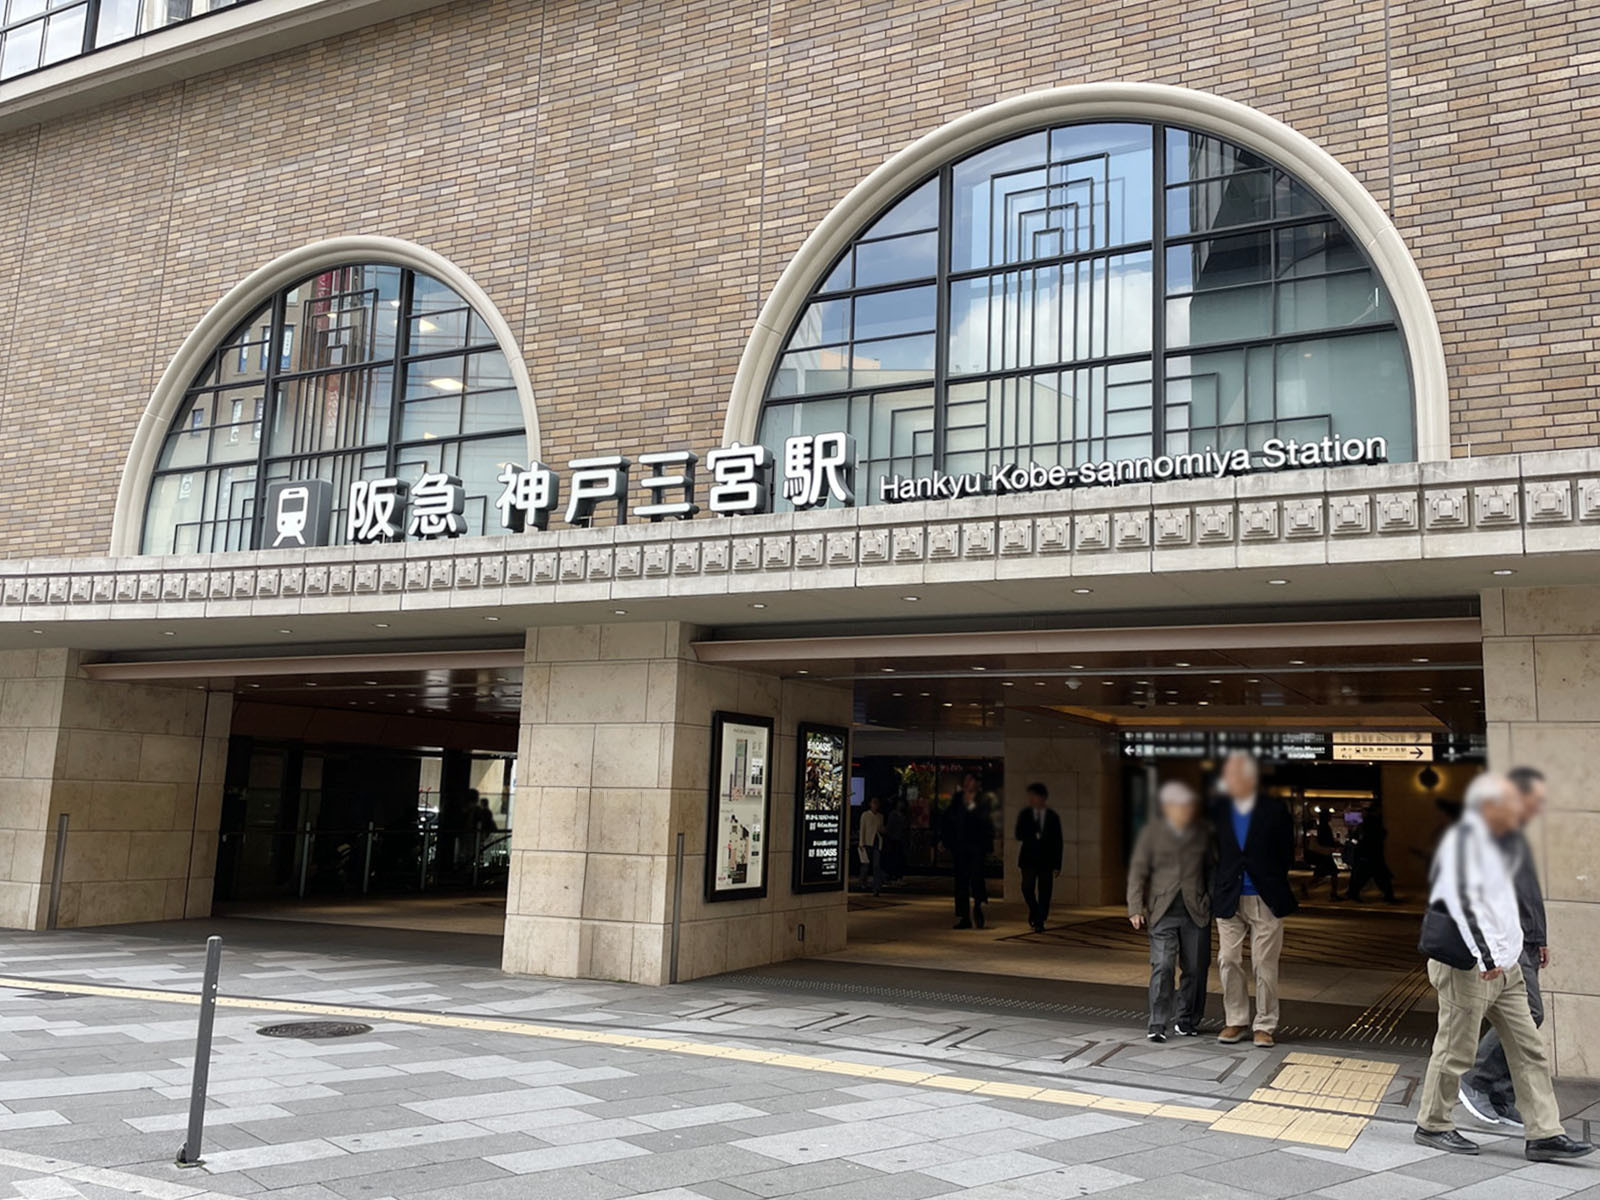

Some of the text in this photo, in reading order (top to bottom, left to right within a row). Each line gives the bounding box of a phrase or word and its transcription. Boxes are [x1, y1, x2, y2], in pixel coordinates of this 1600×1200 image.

[347, 431, 848, 541] 阪急 神戸三宮駅
[880, 434, 1387, 500] Hankyu Kobe-sannomiya Station
